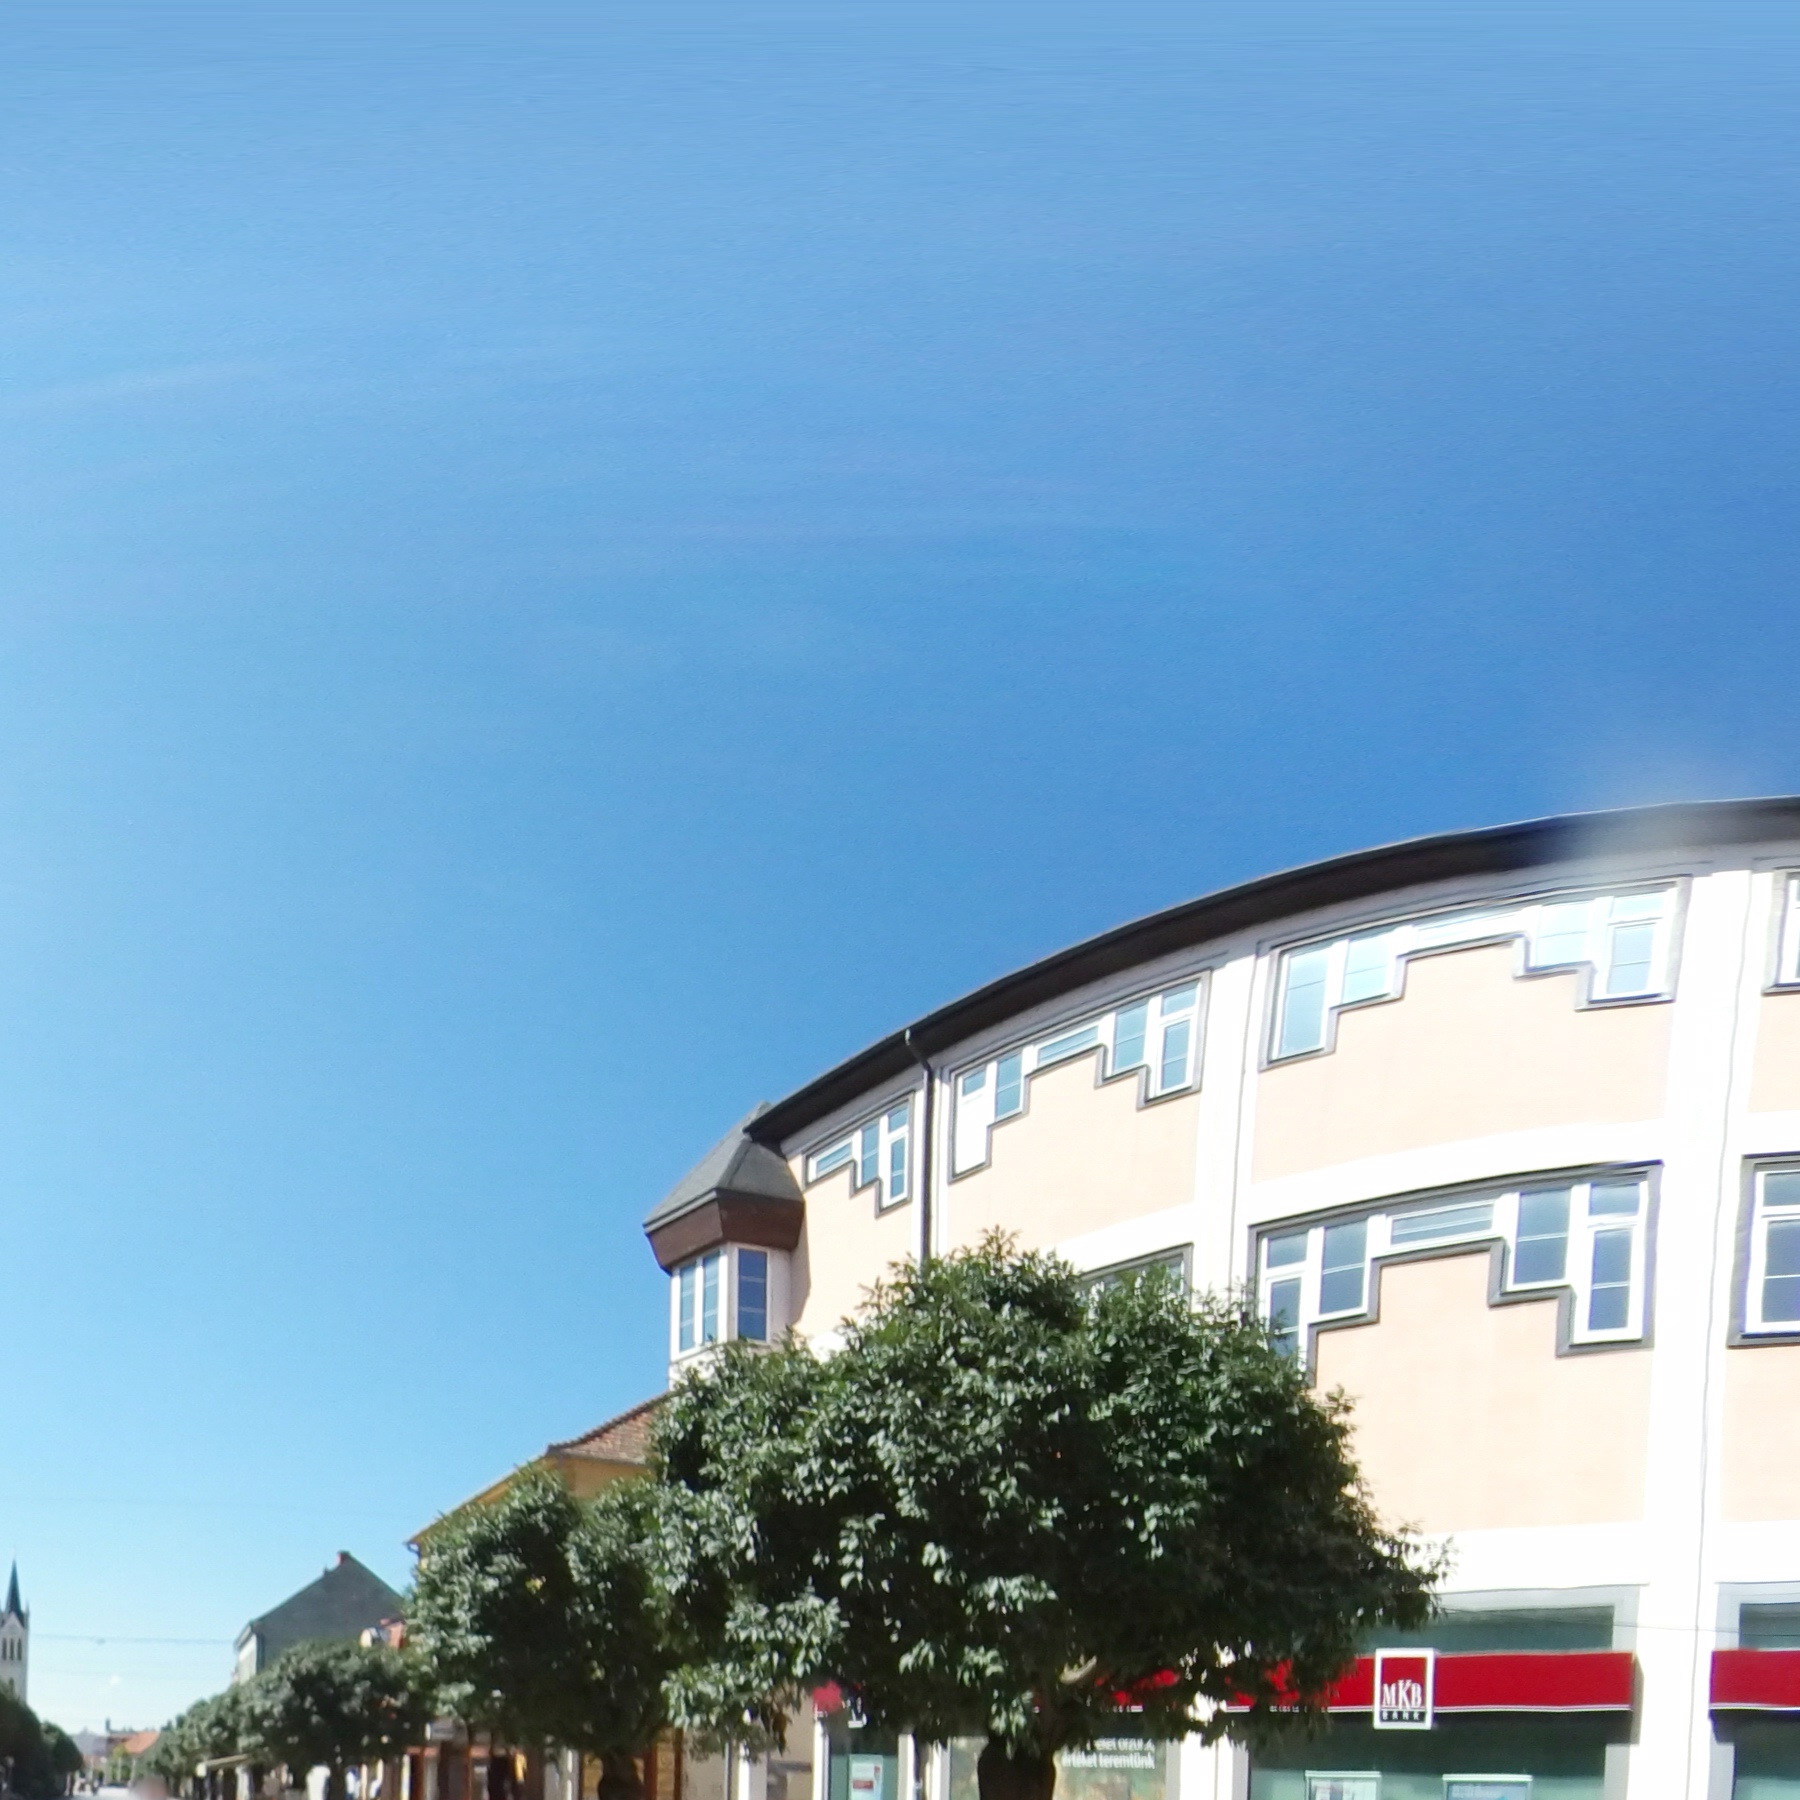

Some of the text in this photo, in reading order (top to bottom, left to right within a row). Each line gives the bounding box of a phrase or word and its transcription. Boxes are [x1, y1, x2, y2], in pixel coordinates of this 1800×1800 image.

[1382, 1679, 1423, 1710] MKB
[1382, 1711, 1420, 1721] BANK
[1099, 1751, 1155, 1769] teremtünk
